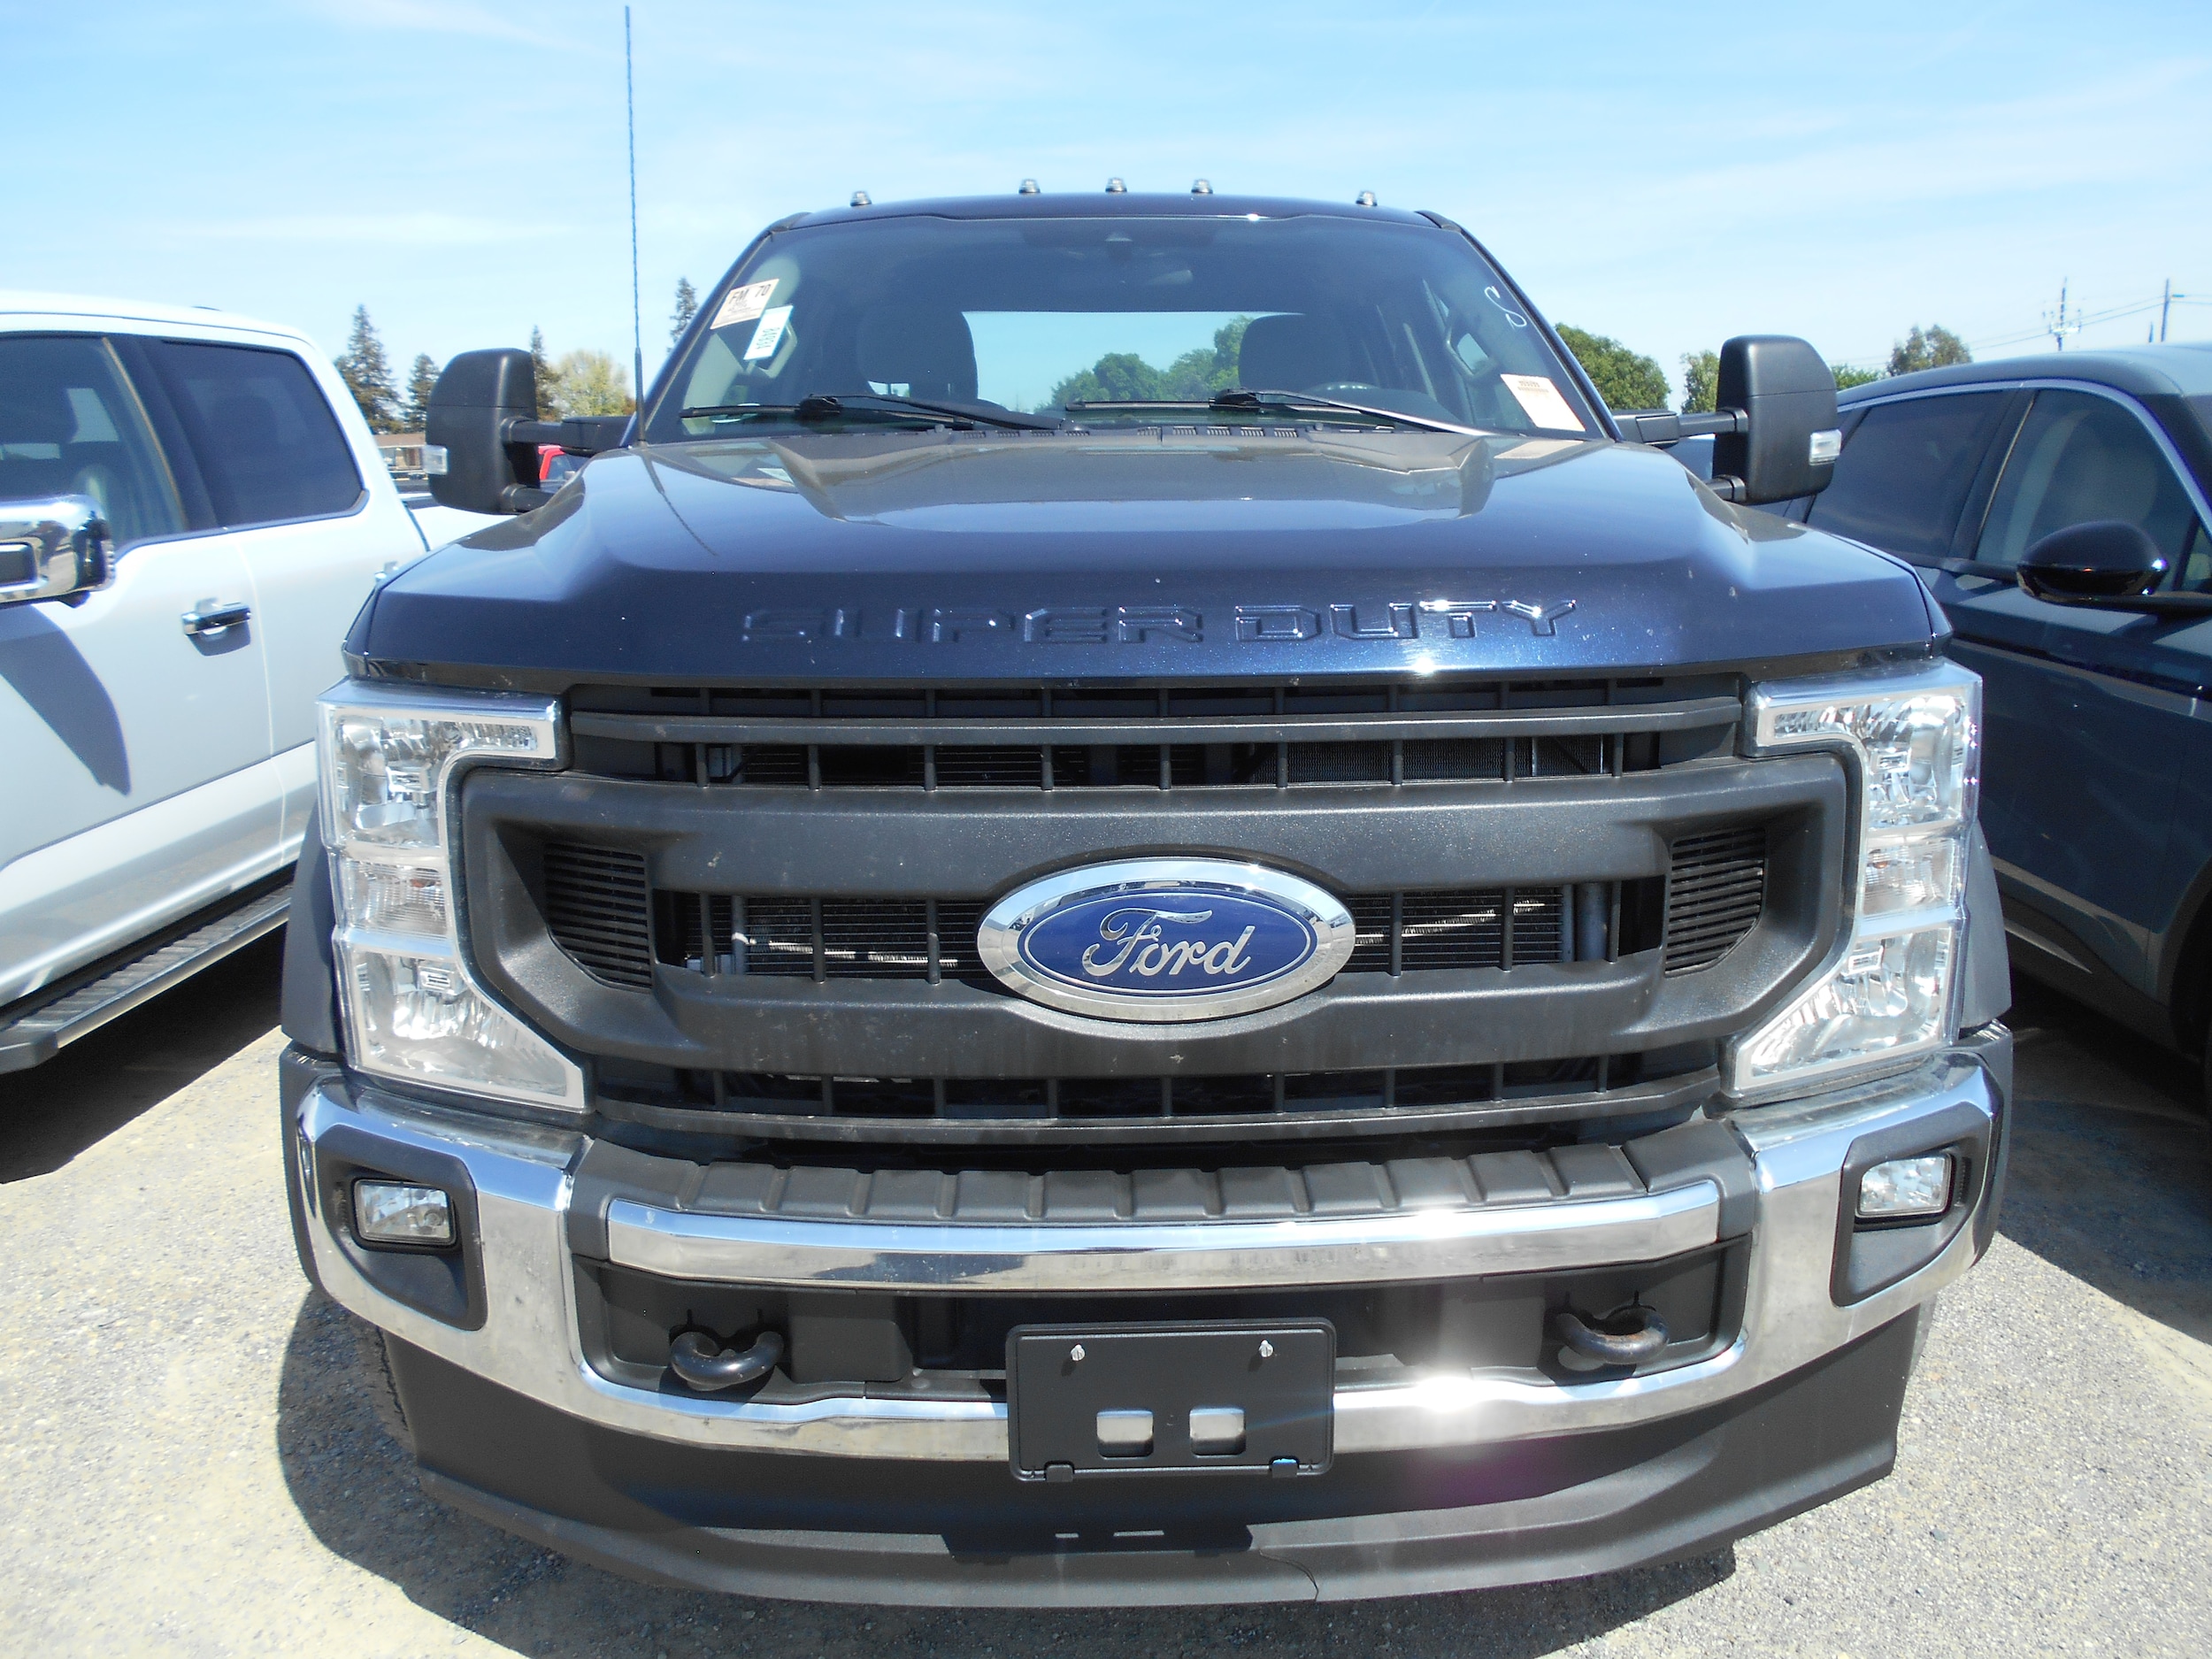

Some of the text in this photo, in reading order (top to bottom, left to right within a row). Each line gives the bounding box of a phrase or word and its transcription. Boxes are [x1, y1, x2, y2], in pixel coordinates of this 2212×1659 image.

[730, 283, 772, 303] FM 70
[741, 599, 1578, 644] SUPER DUTY
[1082, 907, 1256, 977] Ford
